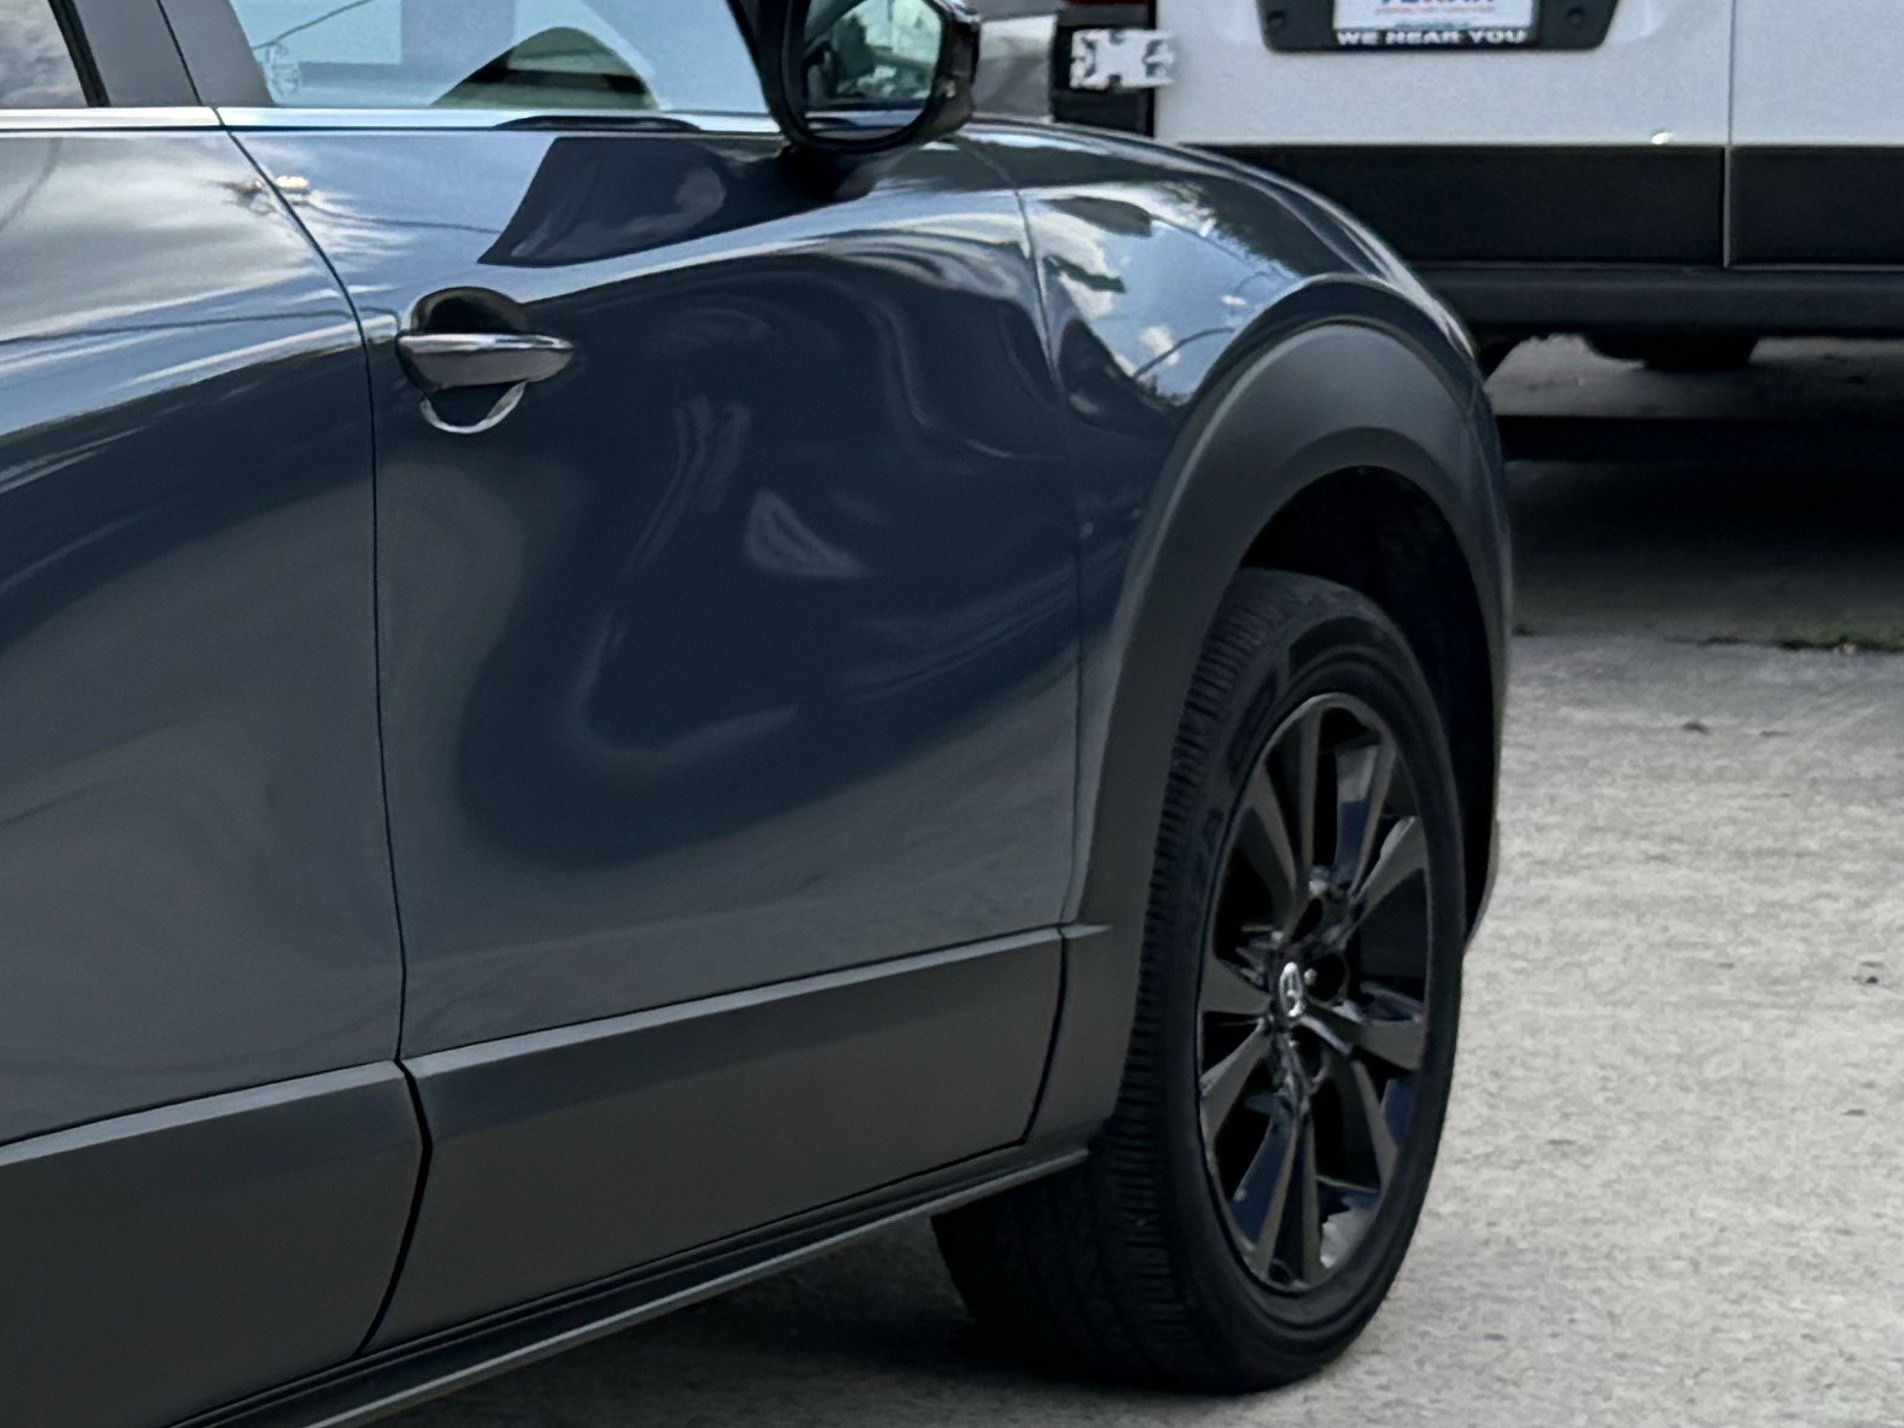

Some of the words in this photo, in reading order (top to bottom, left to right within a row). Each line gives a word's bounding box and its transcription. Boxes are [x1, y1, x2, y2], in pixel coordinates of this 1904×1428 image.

[1337, 32, 1379, 45] WE
[1385, 31, 1462, 45] HEAR
[1468, 29, 1529, 44] YOU
